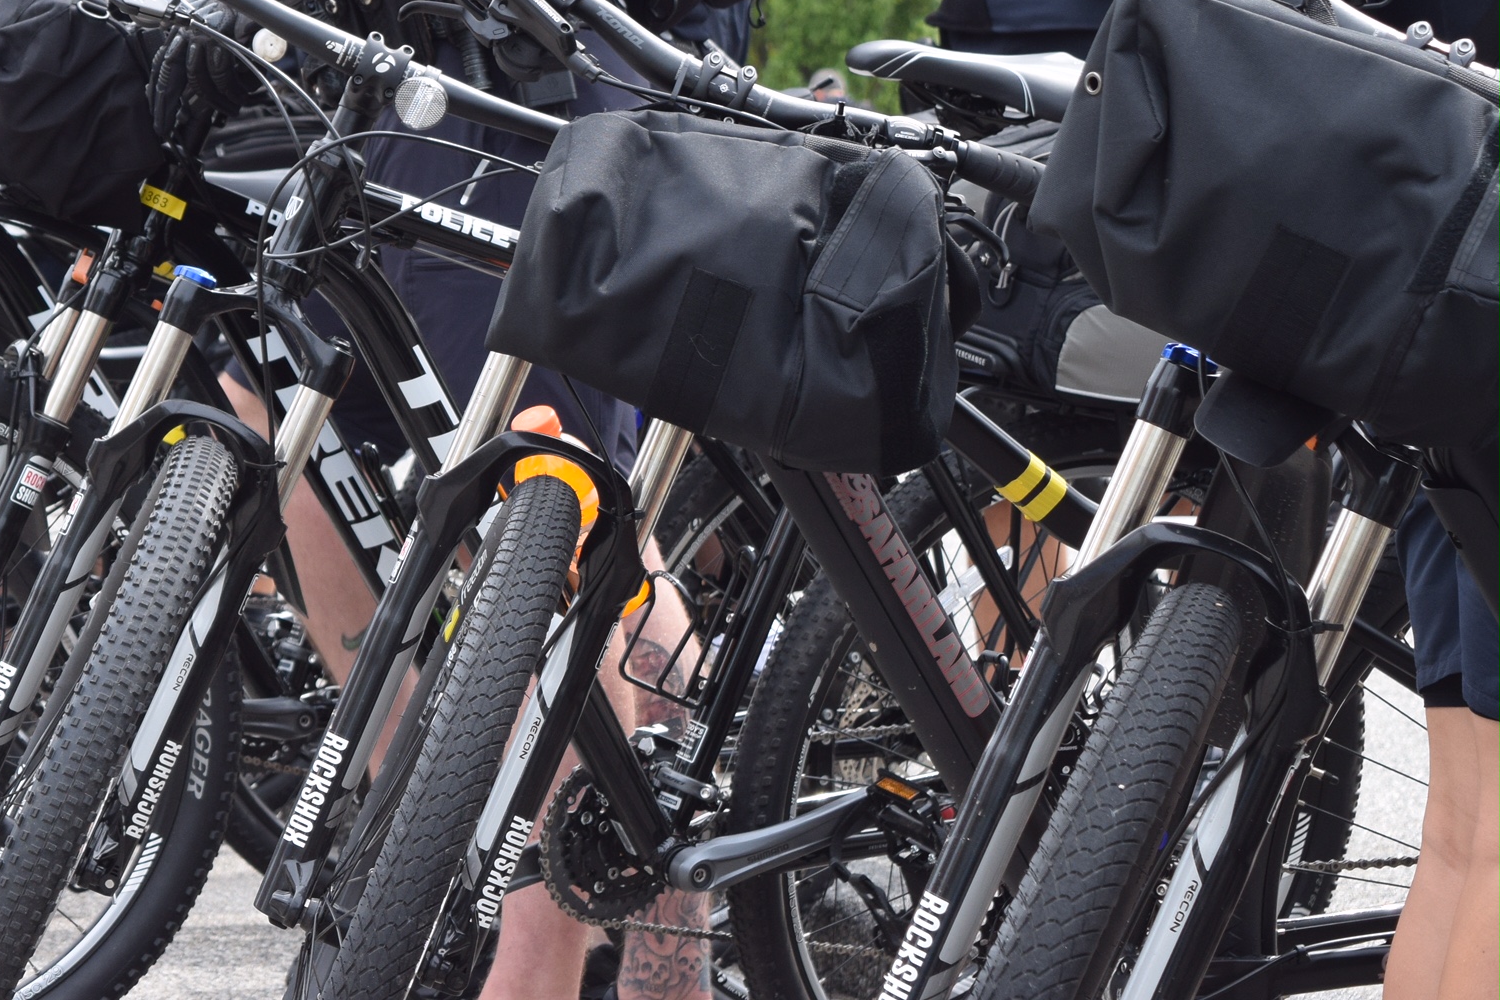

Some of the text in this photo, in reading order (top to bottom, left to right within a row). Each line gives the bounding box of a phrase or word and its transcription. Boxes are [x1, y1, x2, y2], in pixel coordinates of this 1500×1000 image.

[401, 193, 520, 249] POLICE
[955, 348, 986, 367] TERCHANGE
[16, 486, 41, 506] SHO
[172, 653, 194, 692] RECON
[519, 716, 542, 760] RECON
[126, 739, 183, 839] ROCKSHOX
[283, 731, 350, 849] ROCKSHOX
[476, 815, 534, 929] ROCKSHOX
[1169, 879, 1198, 933] RECON
